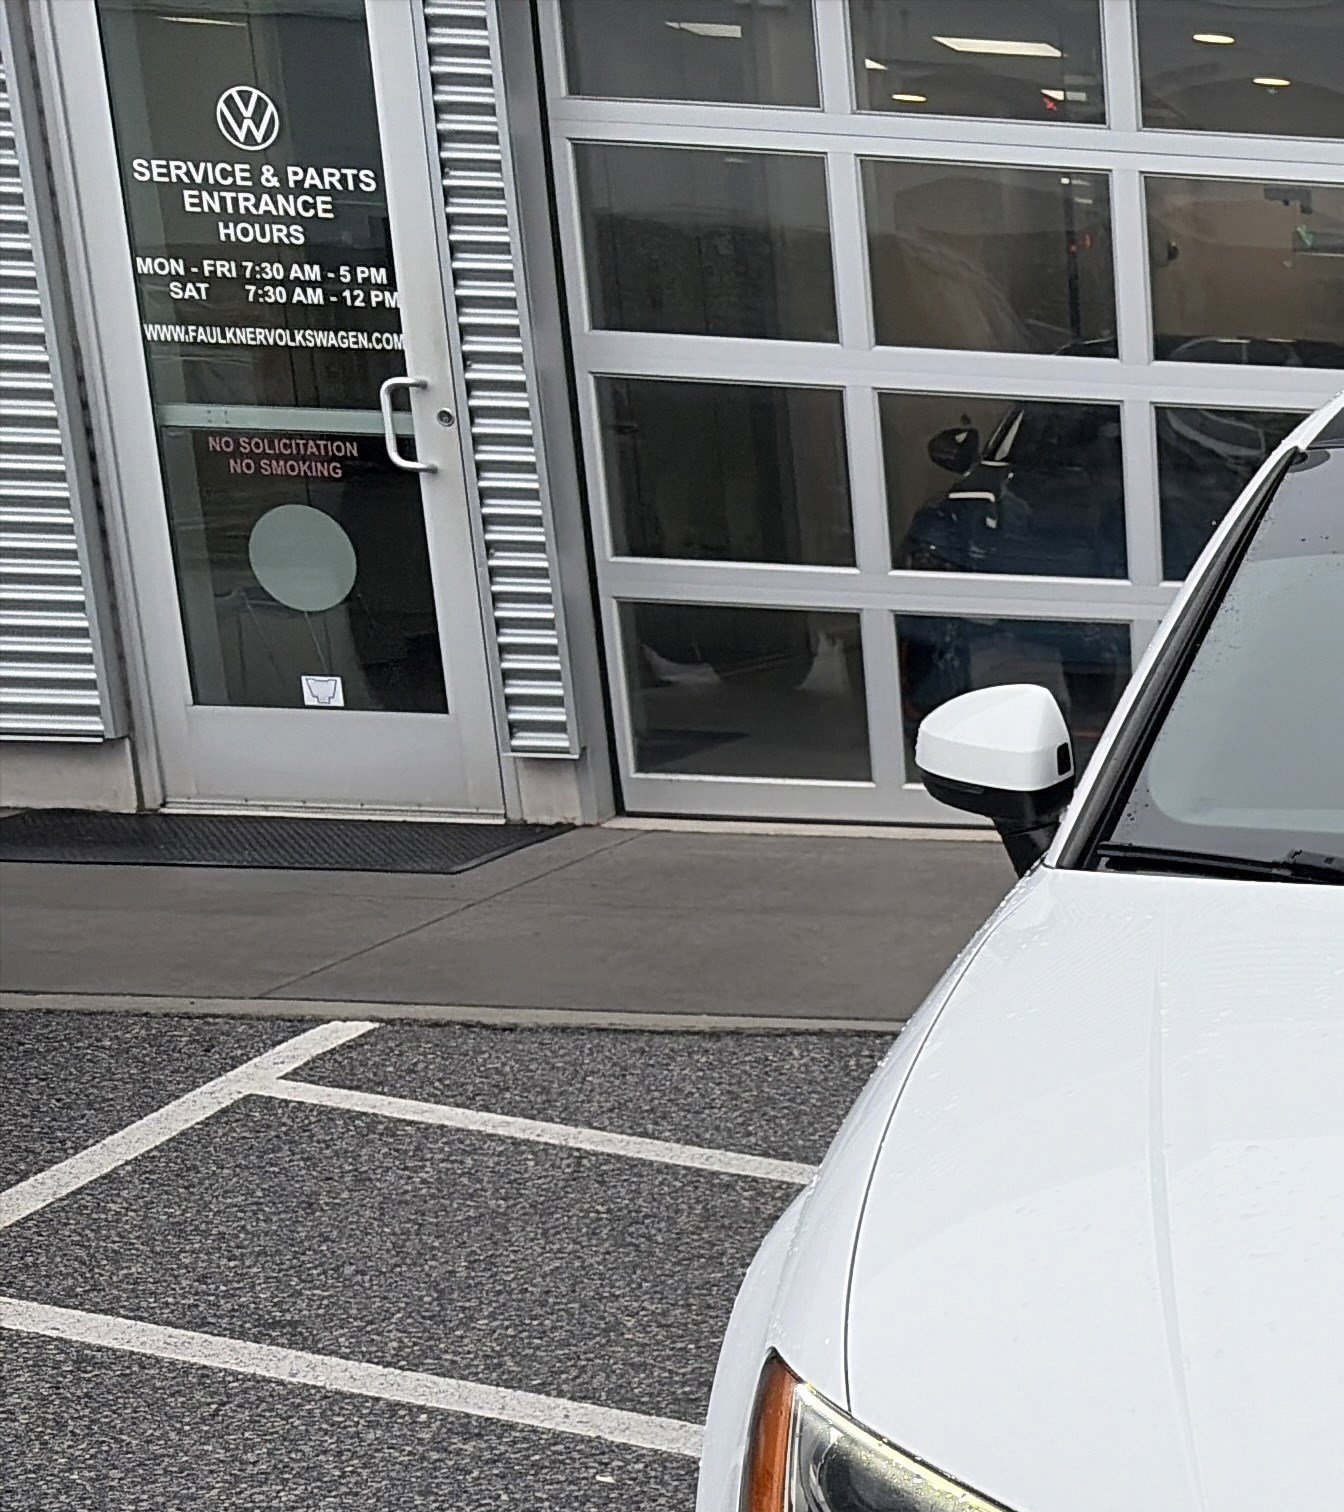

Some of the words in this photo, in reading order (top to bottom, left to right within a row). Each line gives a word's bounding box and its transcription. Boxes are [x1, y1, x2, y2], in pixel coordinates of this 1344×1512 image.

[132, 158, 253, 187] SERVICE
[260, 165, 281, 188] &
[287, 165, 377, 192] PARTS
[182, 189, 335, 219] ENTRANCE
[218, 221, 306, 246] HOURS
[135, 256, 186, 277] MON
[202, 259, 238, 279] FRI
[241, 261, 285, 281] 7:30
[288, 263, 322, 283] AM
[339, 265, 352, 284] 5
[356, 266, 388, 286] PM
[169, 281, 210, 301] SAT
[244, 284, 287, 304] 7:30
[291, 286, 325, 306] AM
[341, 288, 366, 308] 12
[370, 290, 400, 309] PM
[208, 436, 234, 452] NO
[239, 437, 358, 457] SOLICITATION
[229, 458, 255, 474] NO
[260, 459, 343, 478] SMOKING
